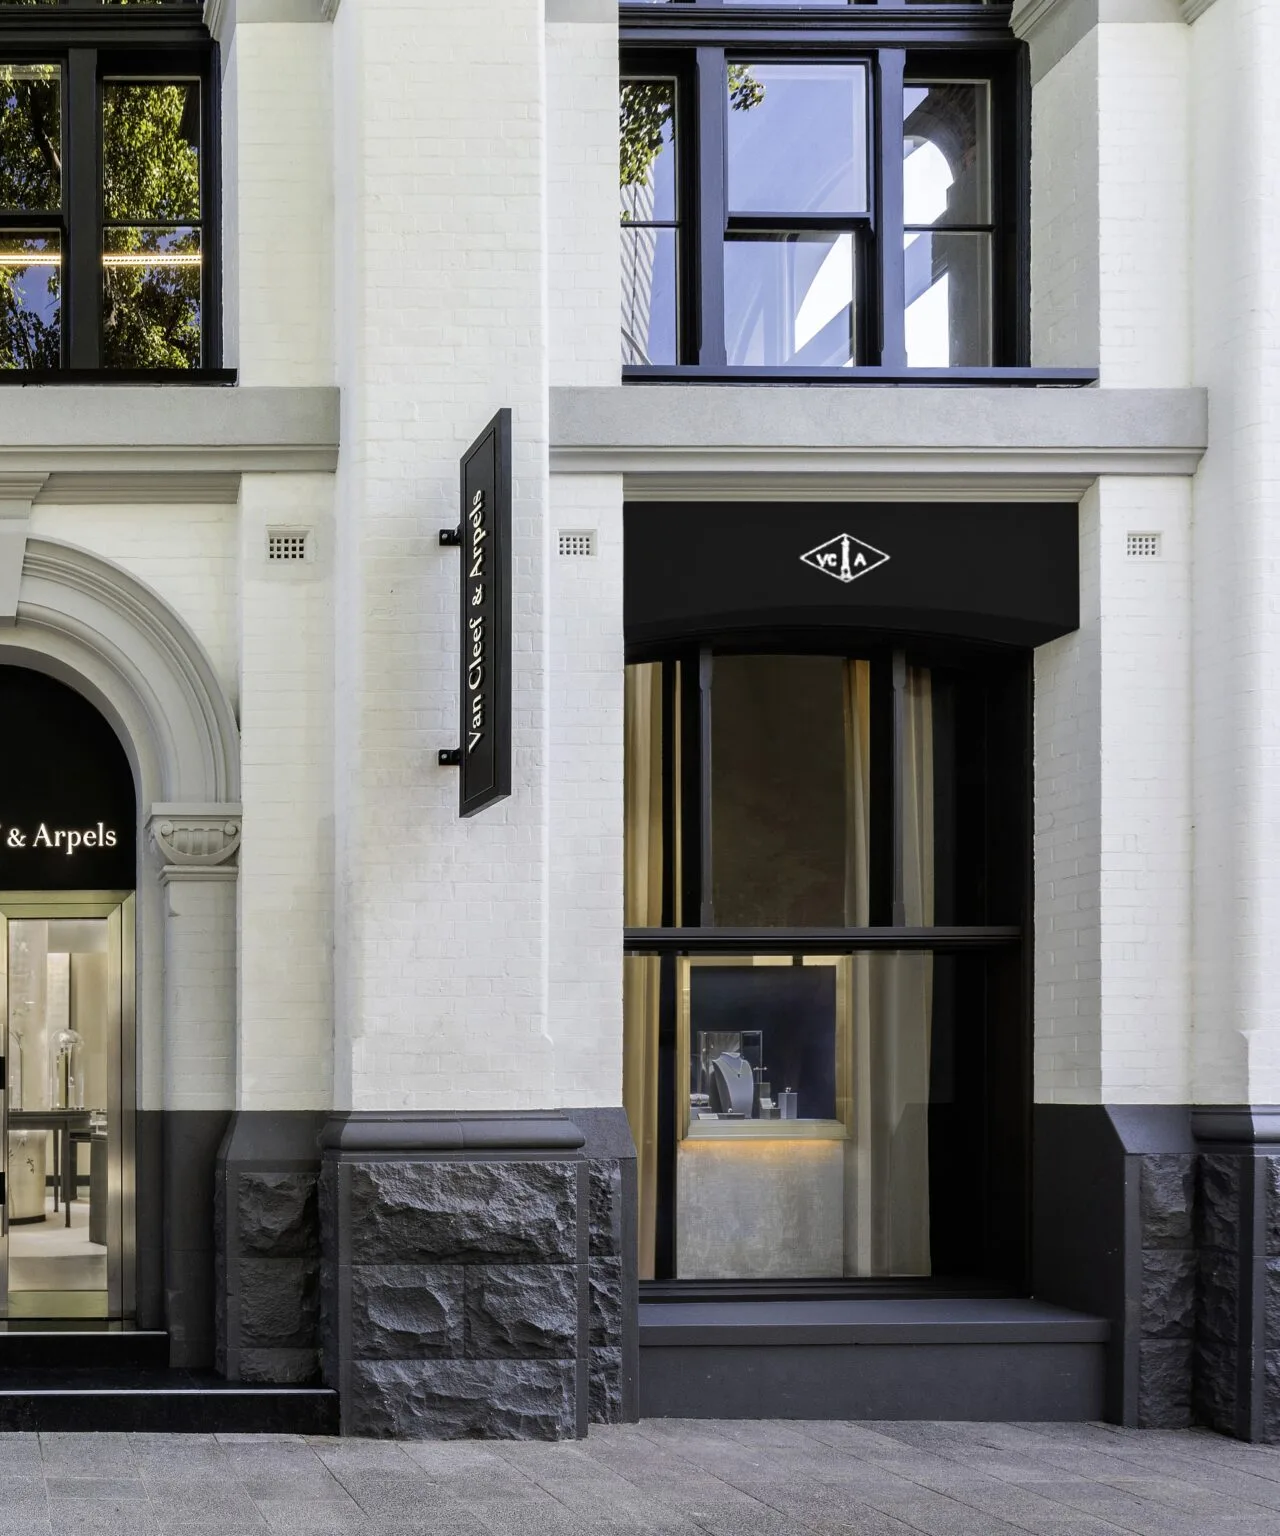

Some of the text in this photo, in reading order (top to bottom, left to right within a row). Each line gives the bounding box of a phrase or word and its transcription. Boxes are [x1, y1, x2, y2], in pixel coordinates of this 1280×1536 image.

[468, 489, 486, 754] Van Cleef & Arpels
[6, 828, 27, 848] &
[32, 822, 117, 855] Arpels
